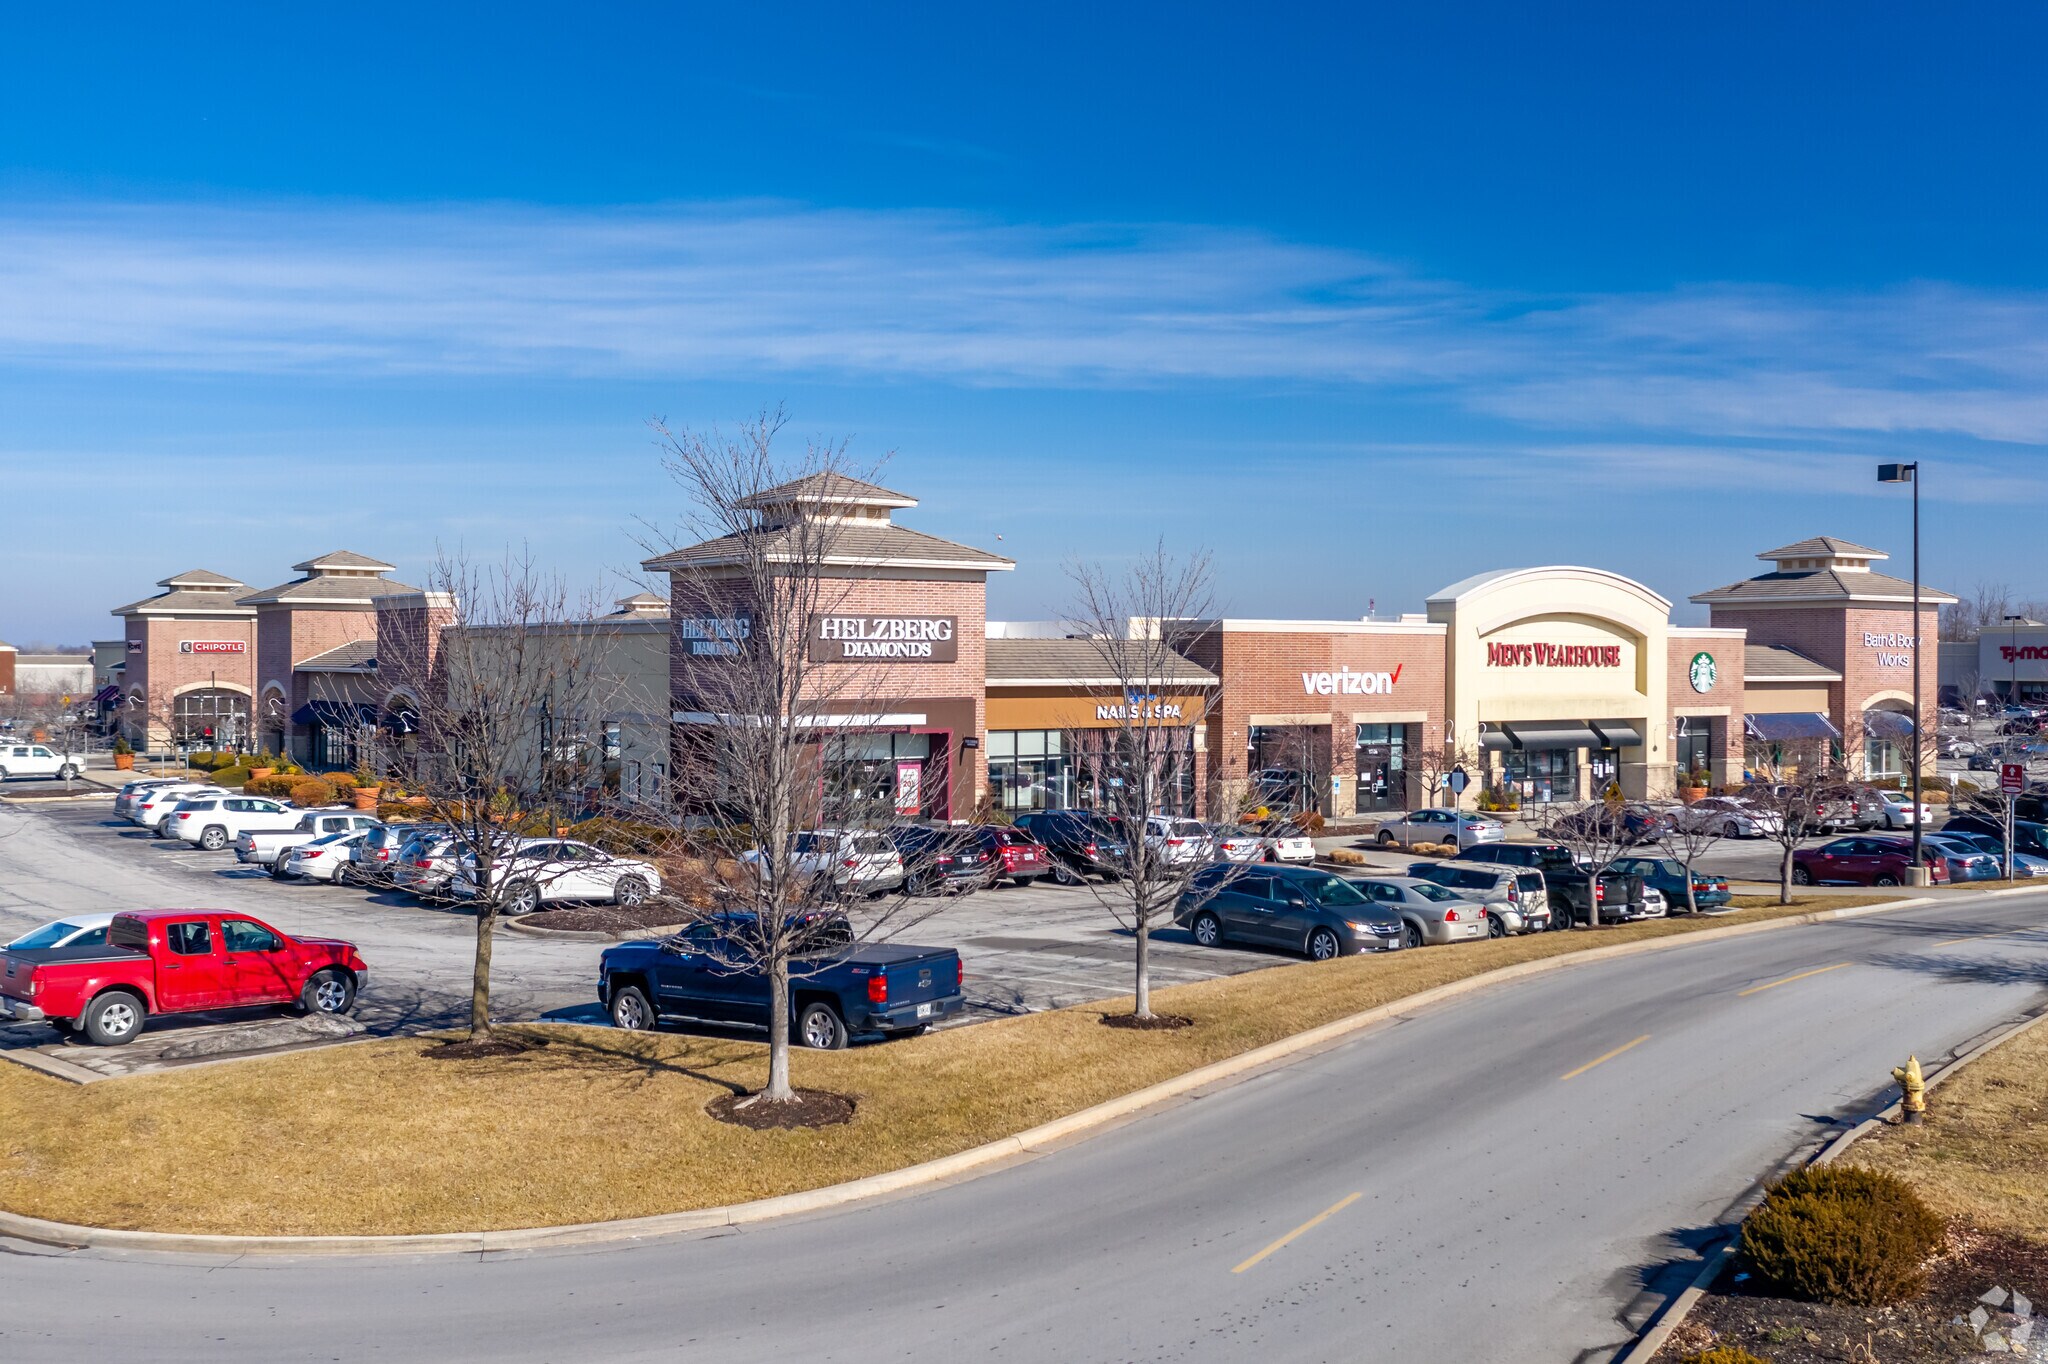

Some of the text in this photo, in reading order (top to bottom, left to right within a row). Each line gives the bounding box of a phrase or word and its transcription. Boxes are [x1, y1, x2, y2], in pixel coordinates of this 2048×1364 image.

[819, 618, 952, 640] HELZBERG
[1864, 632, 1887, 647] Bath
[1888, 633, 1896, 647] &
[195, 643, 244, 652] CHIPOTLE
[842, 641, 932, 657] DIAMONDS
[1487, 642, 1620, 667] MEN'S WEARHOUSE
[1877, 652, 1909, 666] Works
[1301, 665, 1392, 694] verizon
[1154, 705, 1181, 719] SPA
